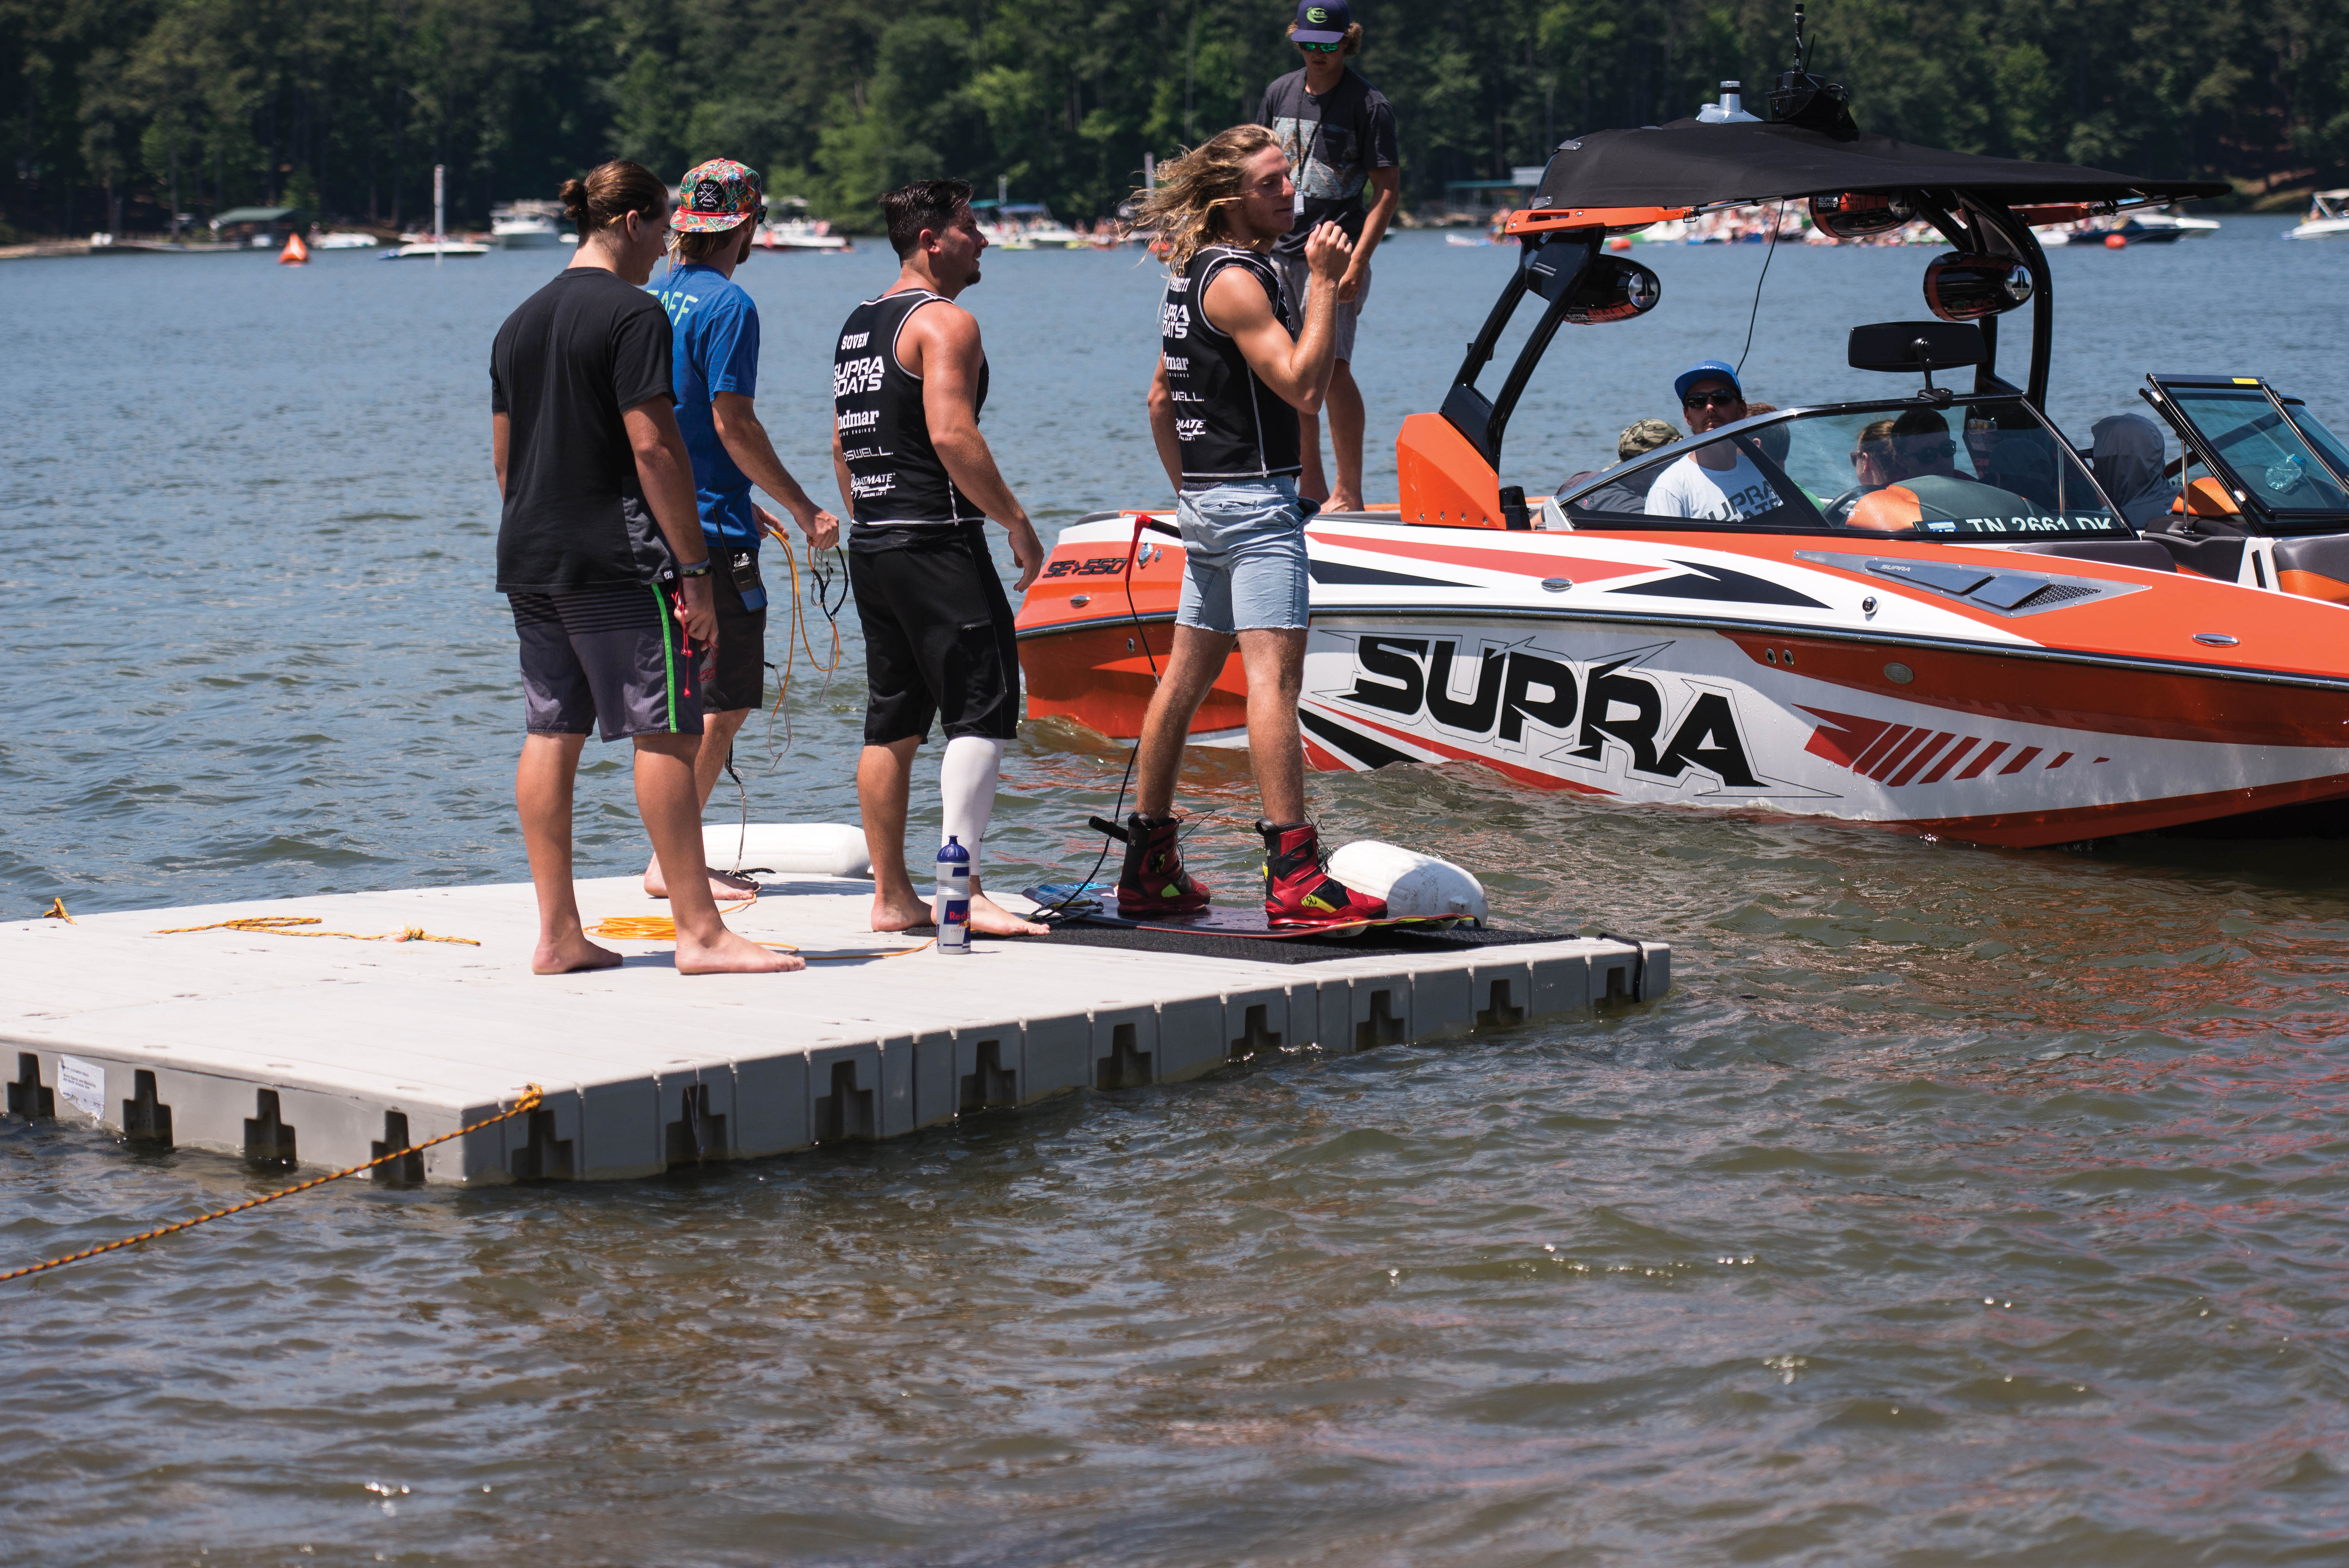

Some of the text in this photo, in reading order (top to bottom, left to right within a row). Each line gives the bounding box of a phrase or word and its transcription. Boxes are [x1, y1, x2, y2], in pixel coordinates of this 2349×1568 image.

[1162, 319, 1189, 339] OATS
[841, 331, 870, 350] SOVEN
[834, 356, 885, 382] SUPRA
[834, 373, 883, 400] BOATS
[837, 410, 879, 430] ndmar
[1965, 518, 2007, 532] TN
[1335, 636, 1772, 788] SUPRA
